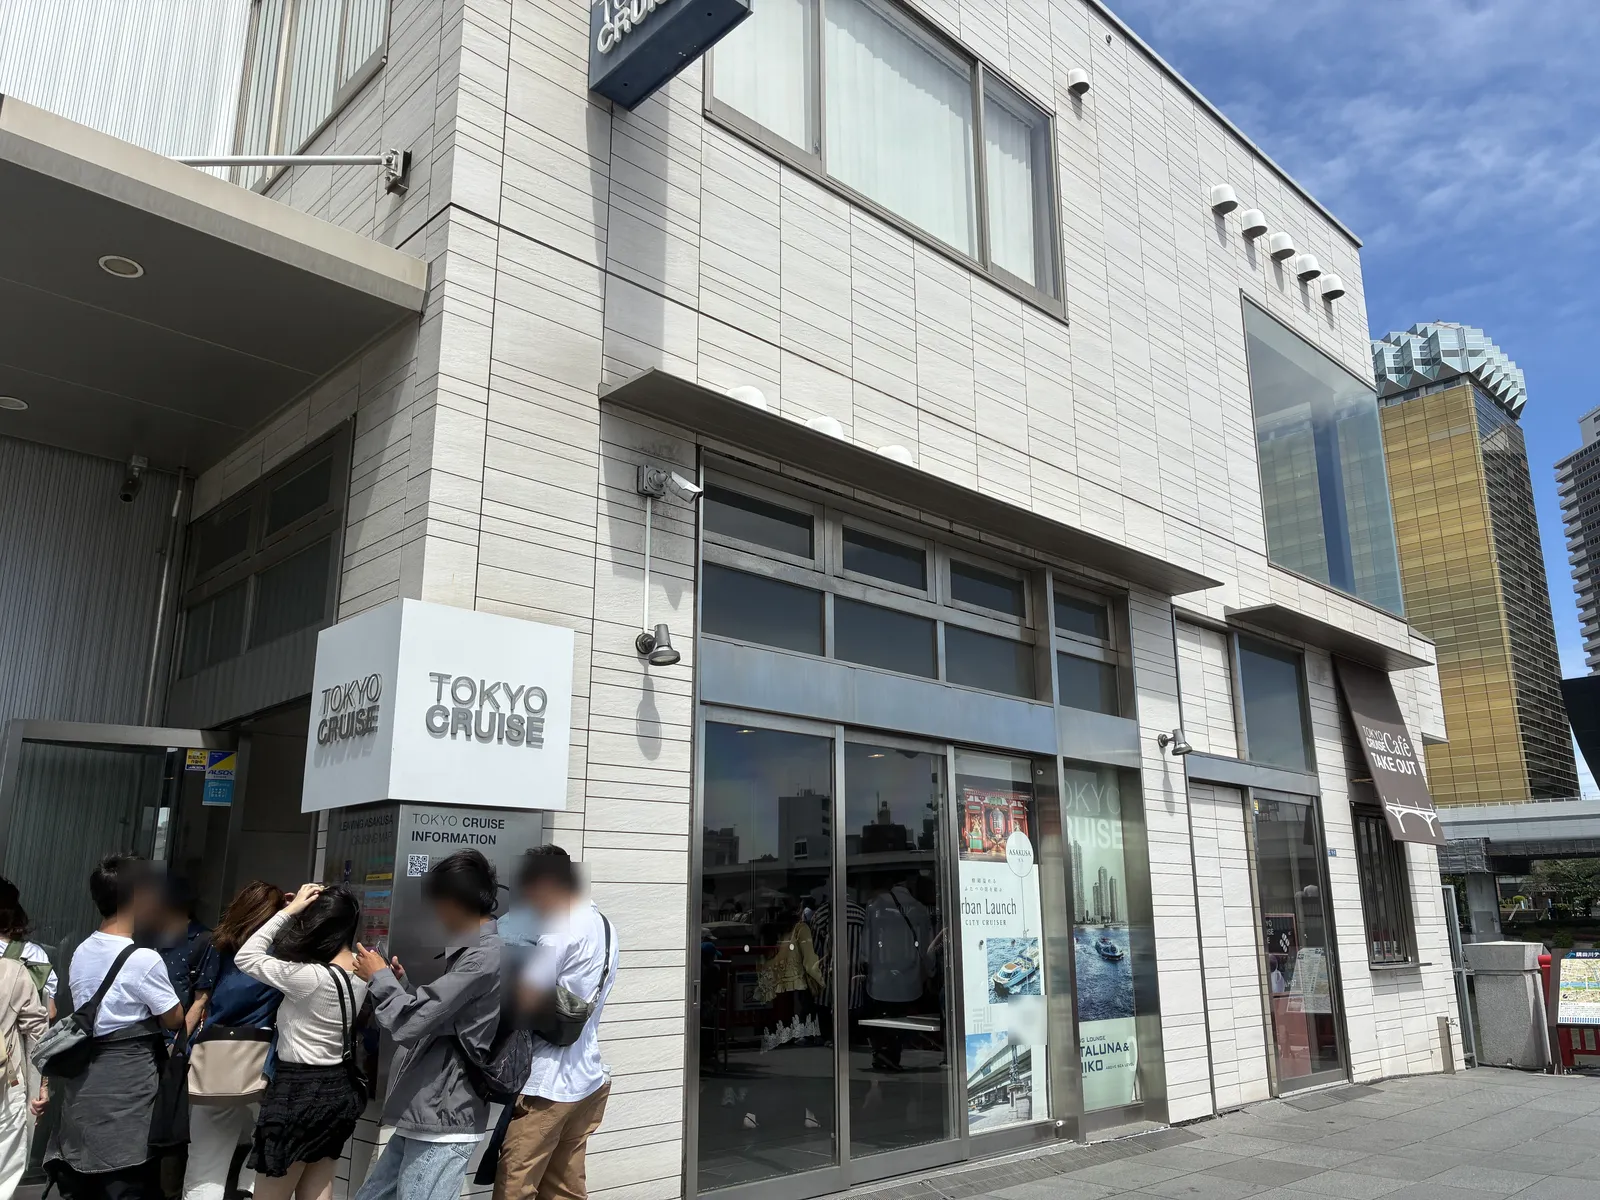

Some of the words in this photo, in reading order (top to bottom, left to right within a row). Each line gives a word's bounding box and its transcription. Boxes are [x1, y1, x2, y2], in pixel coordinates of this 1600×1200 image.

[597, 0, 668, 55] CRUI
[322, 673, 383, 715] TOKYO
[429, 671, 548, 714] TOKYO
[317, 704, 380, 746] CRUISE
[425, 704, 545, 745] CRUISE
[1361, 725, 1384, 741] TOKYO
[1365, 737, 1388, 753] CRUISE
[1383, 732, 1412, 757] Café
[1370, 752, 1397, 772] TAKE
[1396, 758, 1417, 776] OUT
[364, 813, 394, 828] ASAKUSA
[412, 812, 458, 827] TOKYO
[462, 816, 506, 830] CRUISE
[411, 830, 497, 846] INFORMATION
[1008, 848, 1032, 857] ASAKUSA
[985, 897, 1017, 915] Launch
